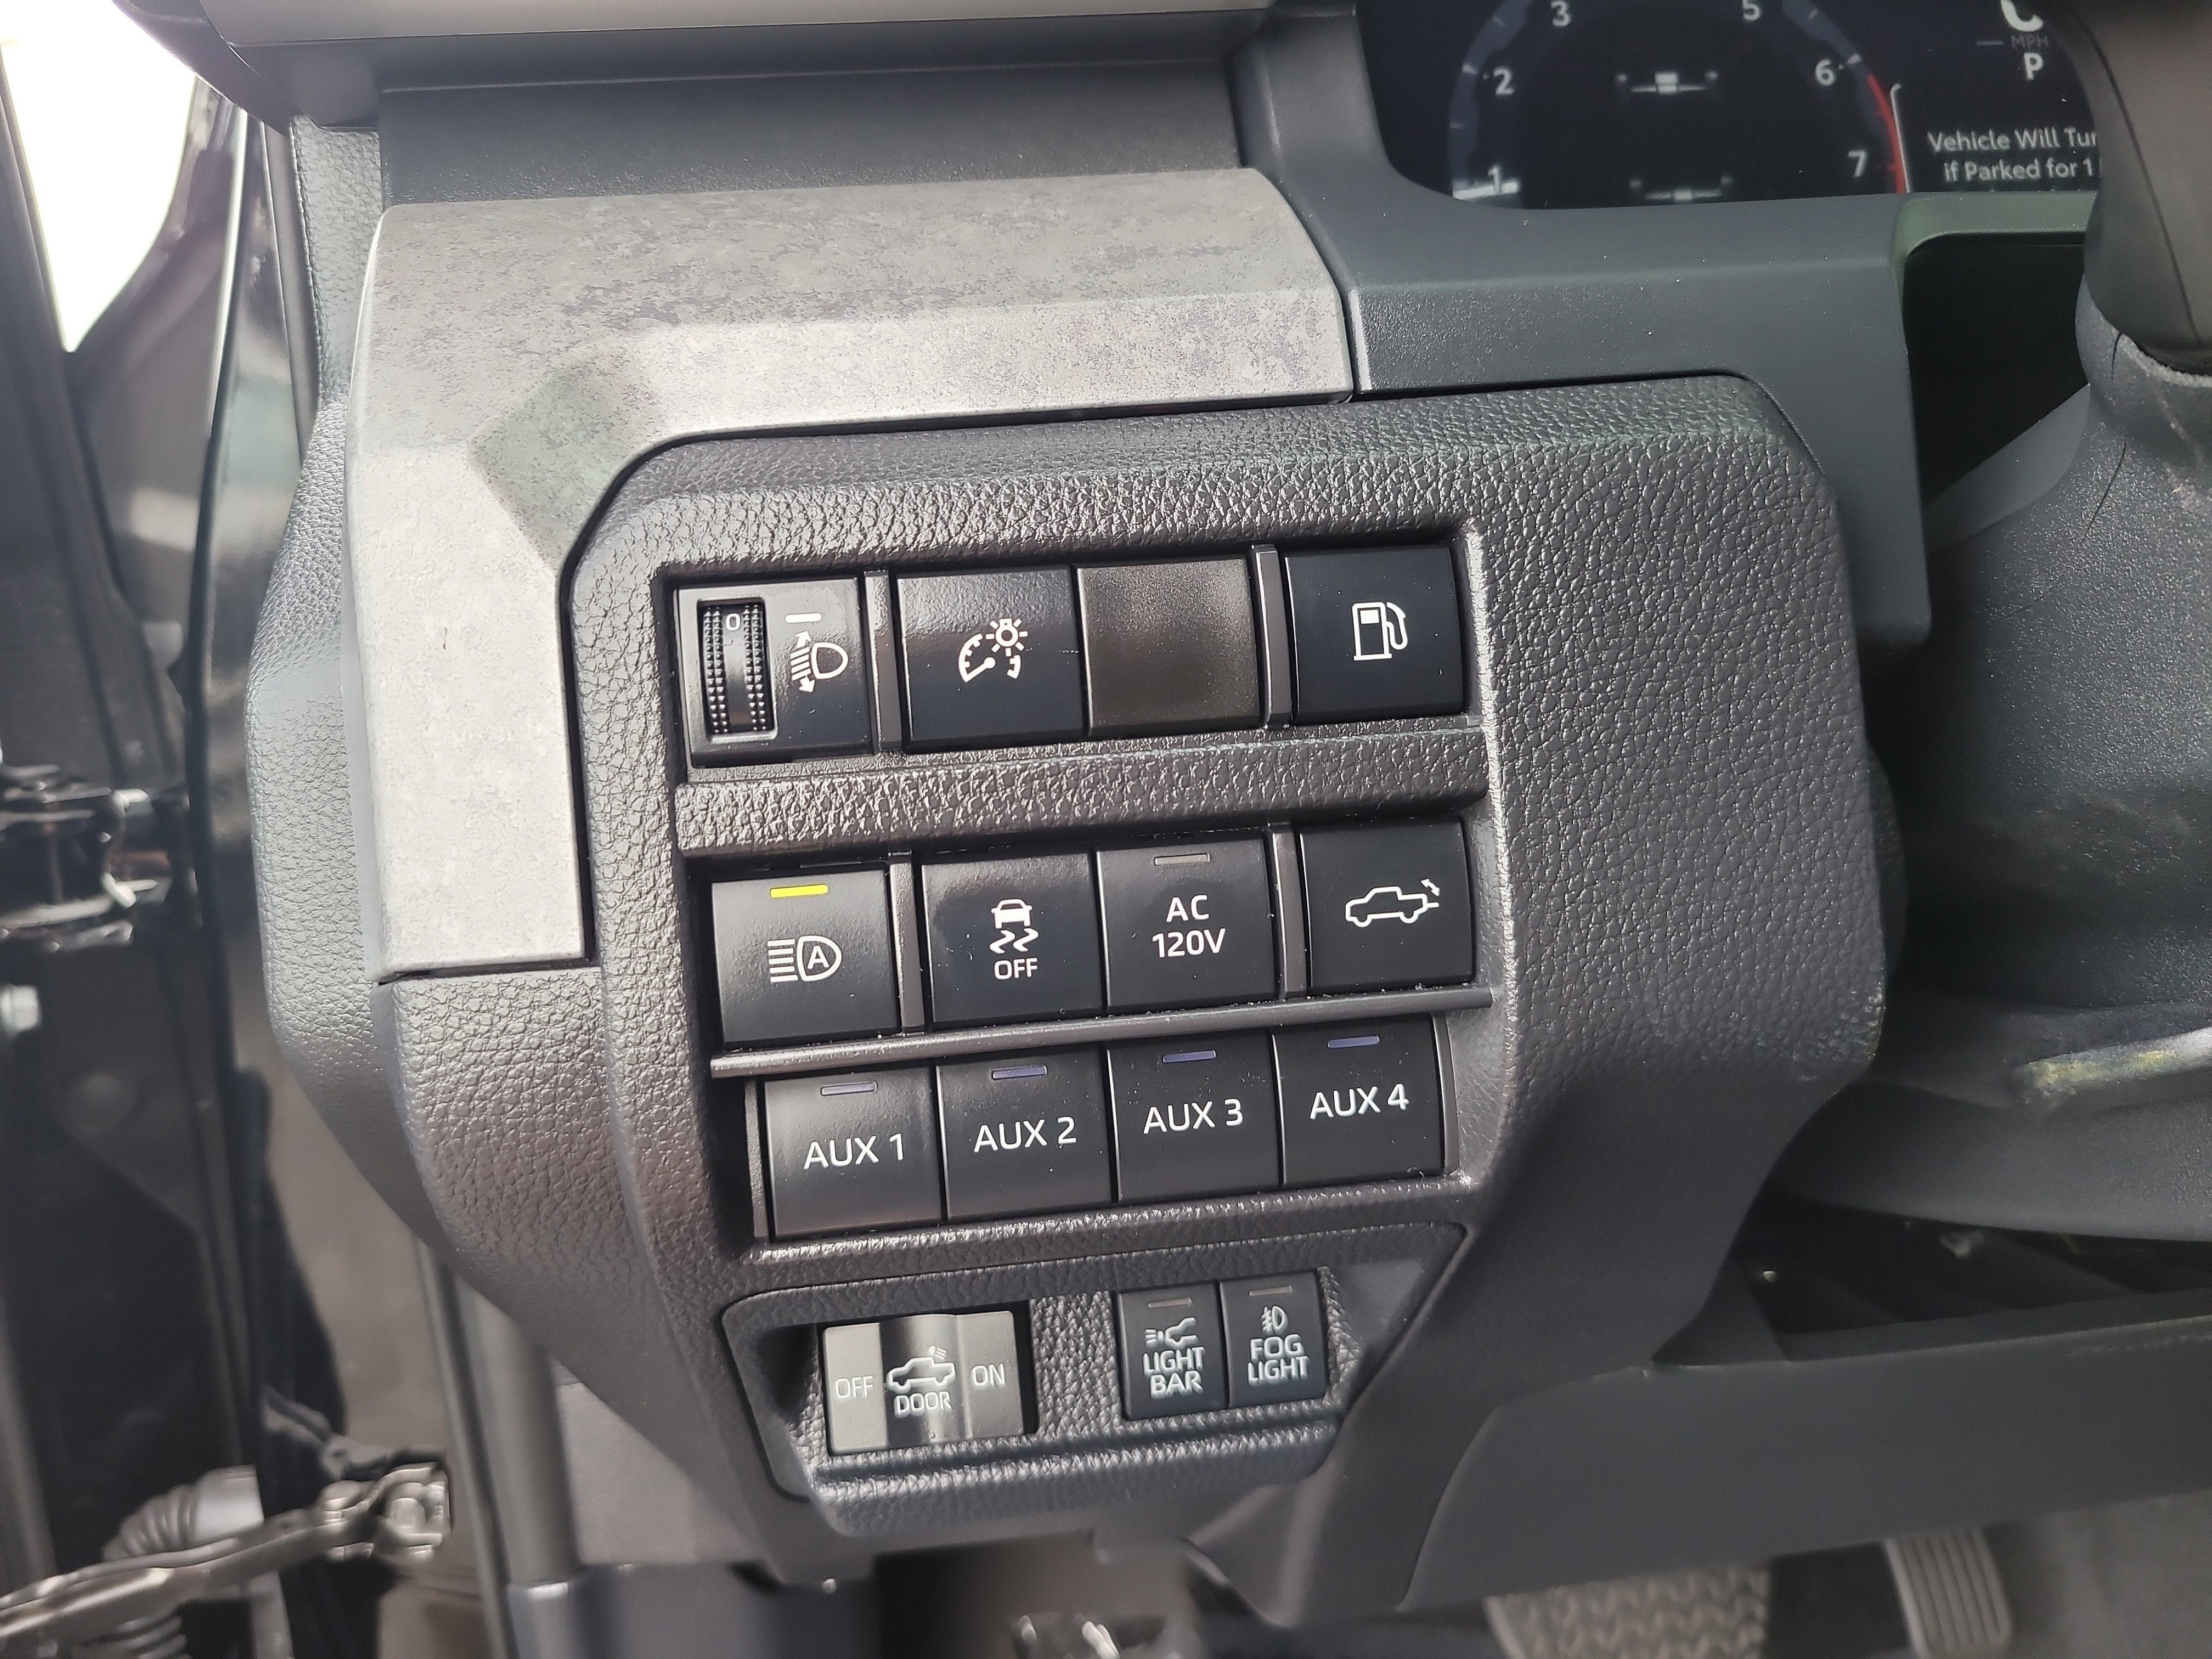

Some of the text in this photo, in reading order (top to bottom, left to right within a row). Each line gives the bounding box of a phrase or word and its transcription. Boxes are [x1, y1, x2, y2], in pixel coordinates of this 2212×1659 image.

[1550, 0, 1572, 27] 3
[1742, 0, 1762, 21] 5
[2011, 35, 2049, 48] MPH
[1492, 66, 1515, 95] 2
[1815, 58, 1836, 86] 6
[2024, 53, 2044, 80] P
[1927, 126, 2097, 153] Vehicle Will Tur
[1847, 149, 1867, 178] 7
[1944, 157, 2094, 182] if Parked for 1
[1487, 164, 1501, 193] 1
[1166, 894, 1210, 923] AC
[1152, 927, 1226, 958] 120V
[807, 945, 830, 969] A
[994, 957, 1039, 980] OFF
[1310, 1082, 1409, 1120] AUX 4
[1143, 1098, 1244, 1135] AUX 3
[973, 1116, 1077, 1153] AUX 2
[804, 1132, 904, 1170] AUX 1
[1143, 1346, 1206, 1378] LIGHT
[1250, 1334, 1305, 1362] FOG
[971, 1363, 1006, 1389] ON
[1150, 1370, 1204, 1399] BAR
[1247, 1355, 1311, 1386] LIGHT
[835, 1375, 874, 1400] OFF
[894, 1391, 952, 1419] DOOR
